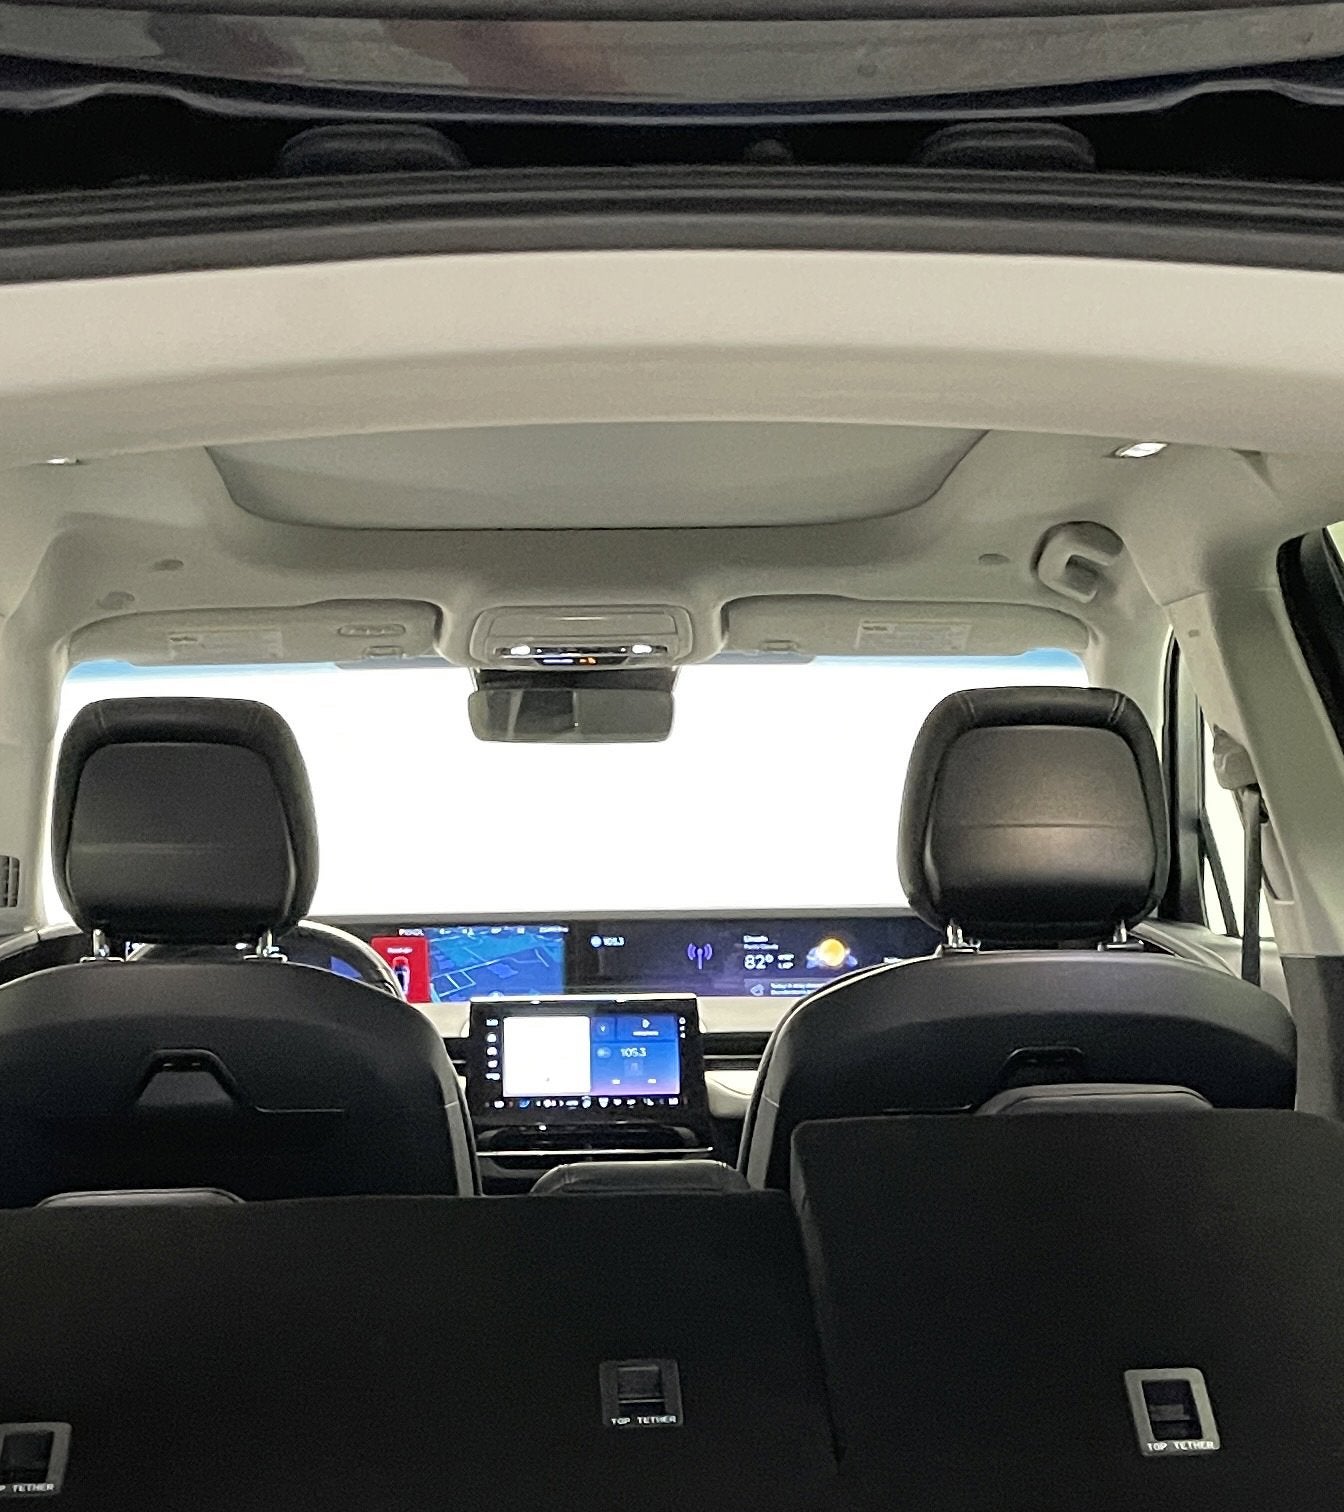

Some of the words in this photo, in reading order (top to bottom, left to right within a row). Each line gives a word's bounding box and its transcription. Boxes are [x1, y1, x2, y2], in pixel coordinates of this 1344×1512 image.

[620, 1047, 647, 1058] 105.3
[611, 1417, 631, 1425] TOP
[637, 1415, 677, 1424] TETHER
[1146, 1442, 1168, 1452] TOP
[1173, 1441, 1214, 1451] TETHER
[13, 1483, 55, 1493] TETHER
